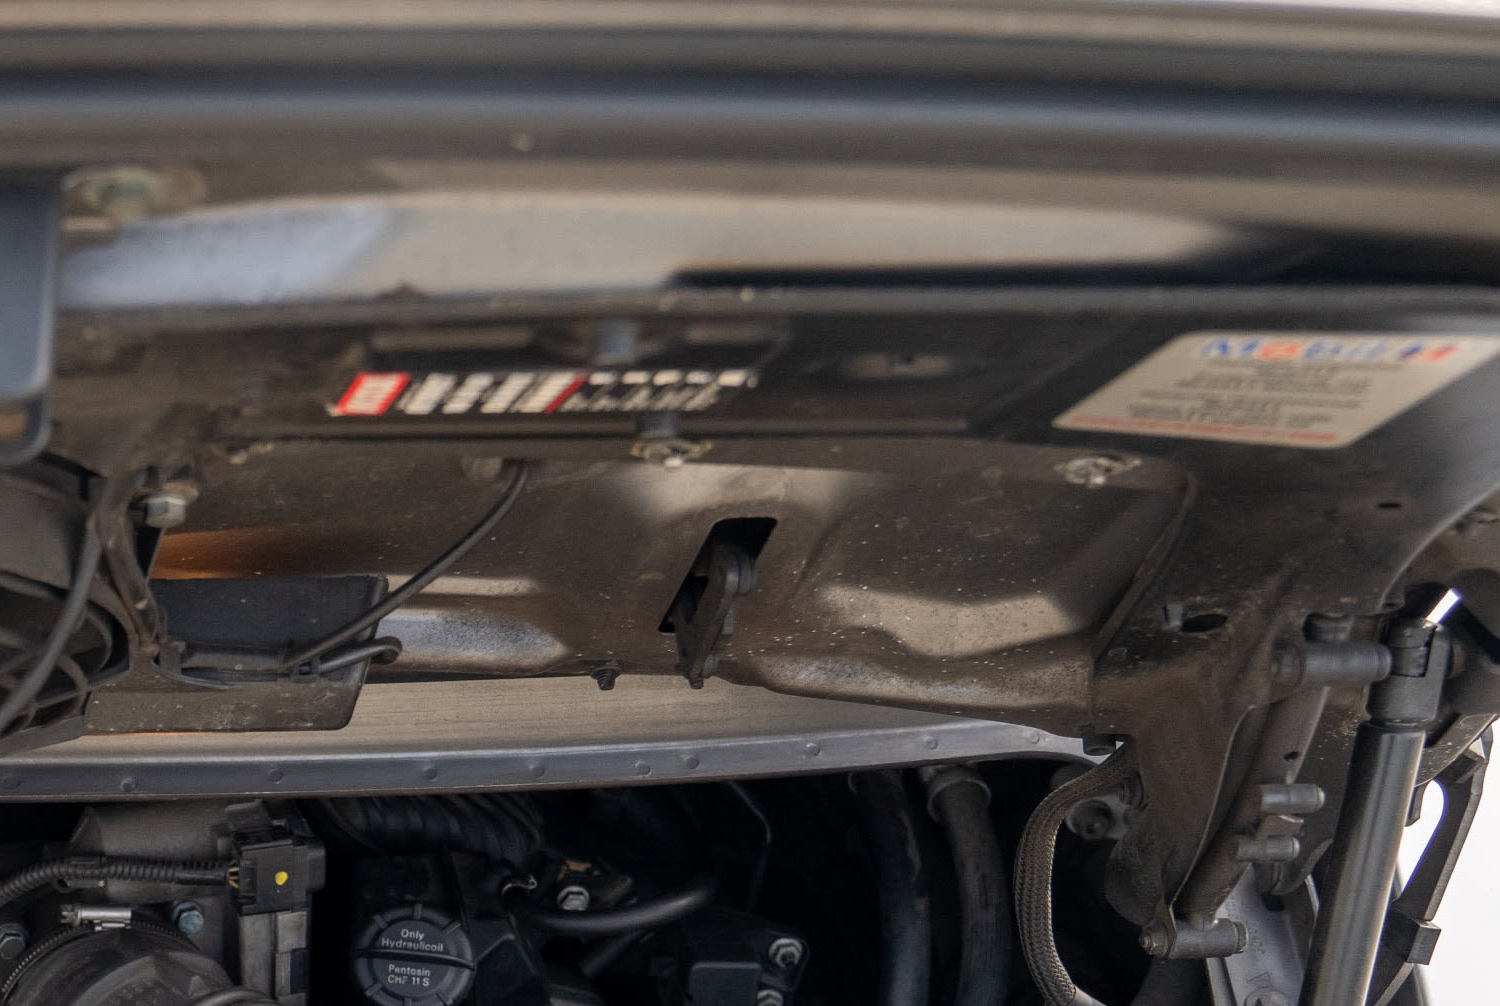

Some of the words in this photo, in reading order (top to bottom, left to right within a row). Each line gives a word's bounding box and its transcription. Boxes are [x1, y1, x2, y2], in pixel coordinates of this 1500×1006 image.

[400, 928, 425, 940] Only
[381, 937, 444, 952] Hydraulicoil
[388, 963, 431, 977] Pentosin
[387, 975, 408, 985] CHF
[412, 976, 420, 985] 11
[422, 977, 430, 987] S
